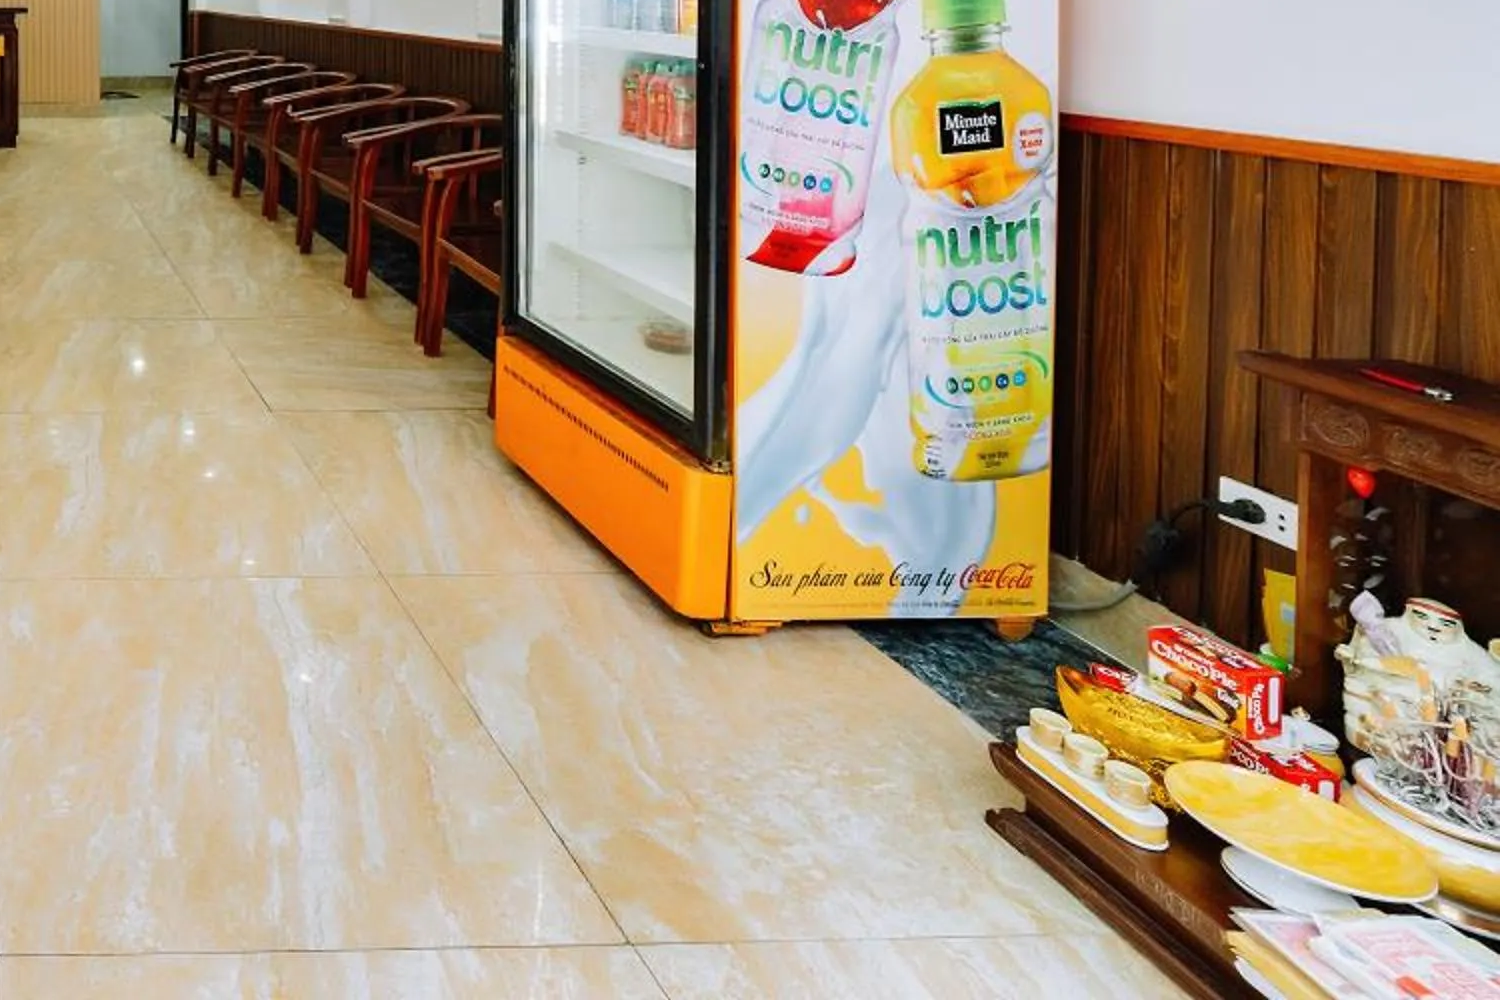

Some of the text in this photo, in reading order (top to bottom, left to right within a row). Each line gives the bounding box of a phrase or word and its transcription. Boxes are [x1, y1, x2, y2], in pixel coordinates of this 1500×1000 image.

[753, 59, 874, 128] boost
[944, 111, 998, 132] Minute
[952, 126, 991, 147] Maid
[921, 261, 1048, 319] boost
[936, 567, 957, 595] ty
